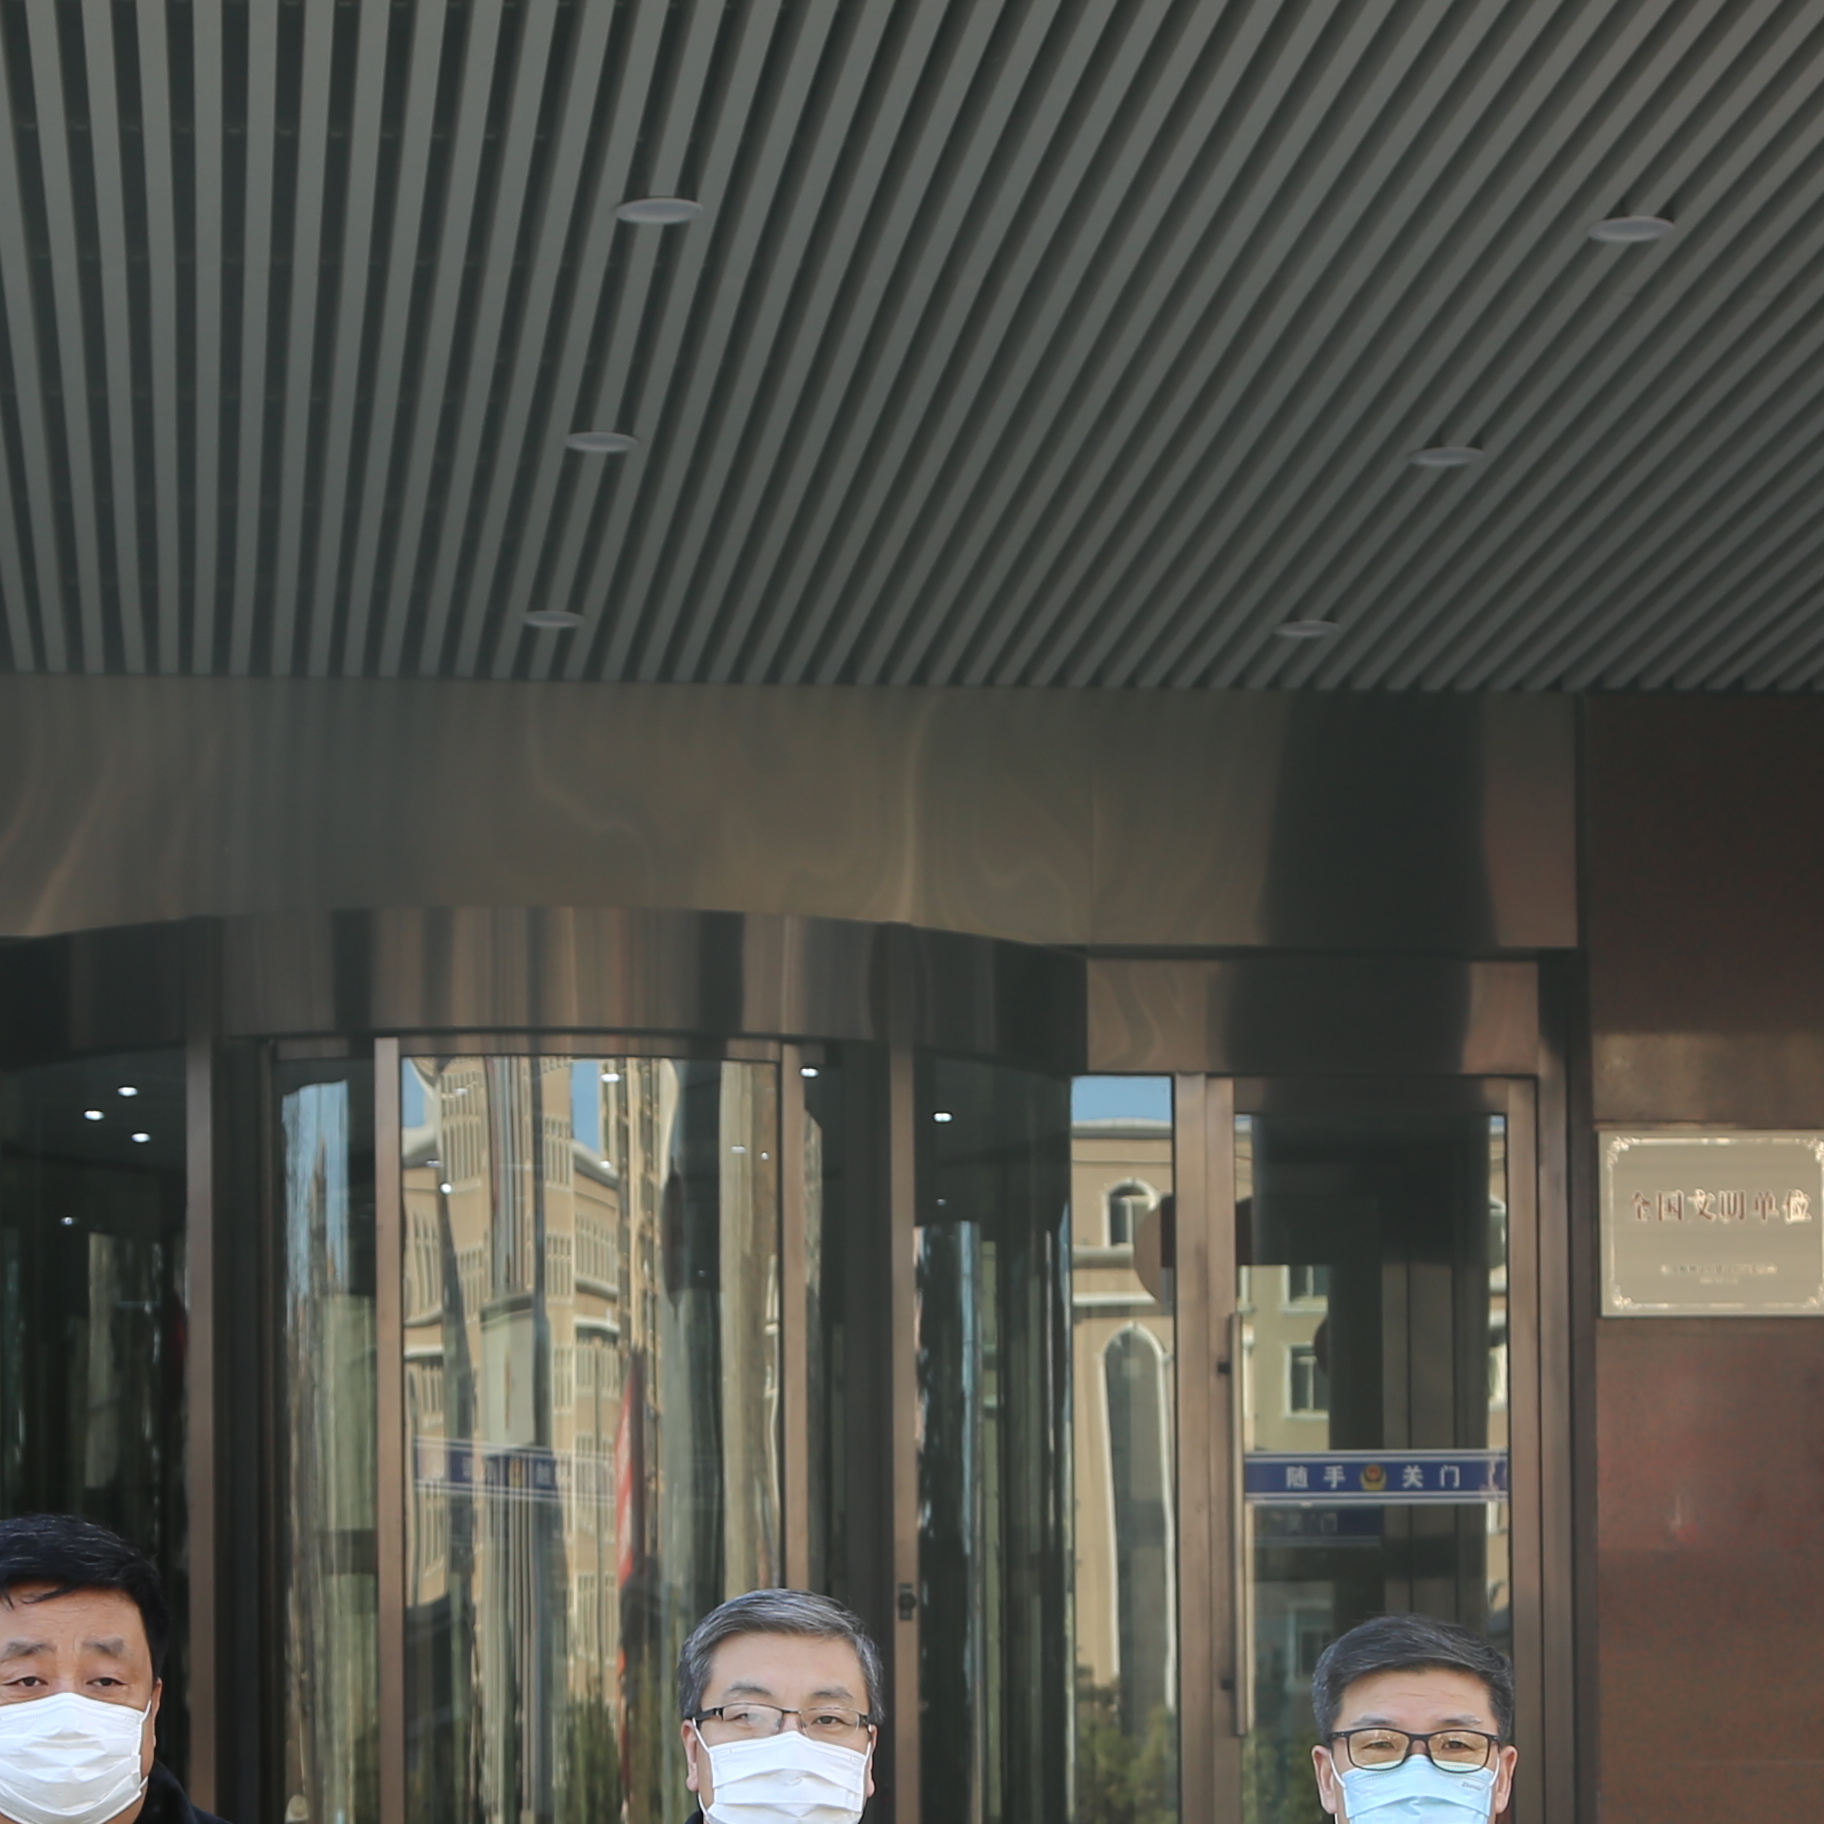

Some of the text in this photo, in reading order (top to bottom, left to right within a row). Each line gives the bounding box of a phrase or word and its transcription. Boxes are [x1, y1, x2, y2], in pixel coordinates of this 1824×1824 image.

[1631, 1189, 1812, 1224] 全国文明单位
[1285, 1464, 1461, 1490] 随手 关门
